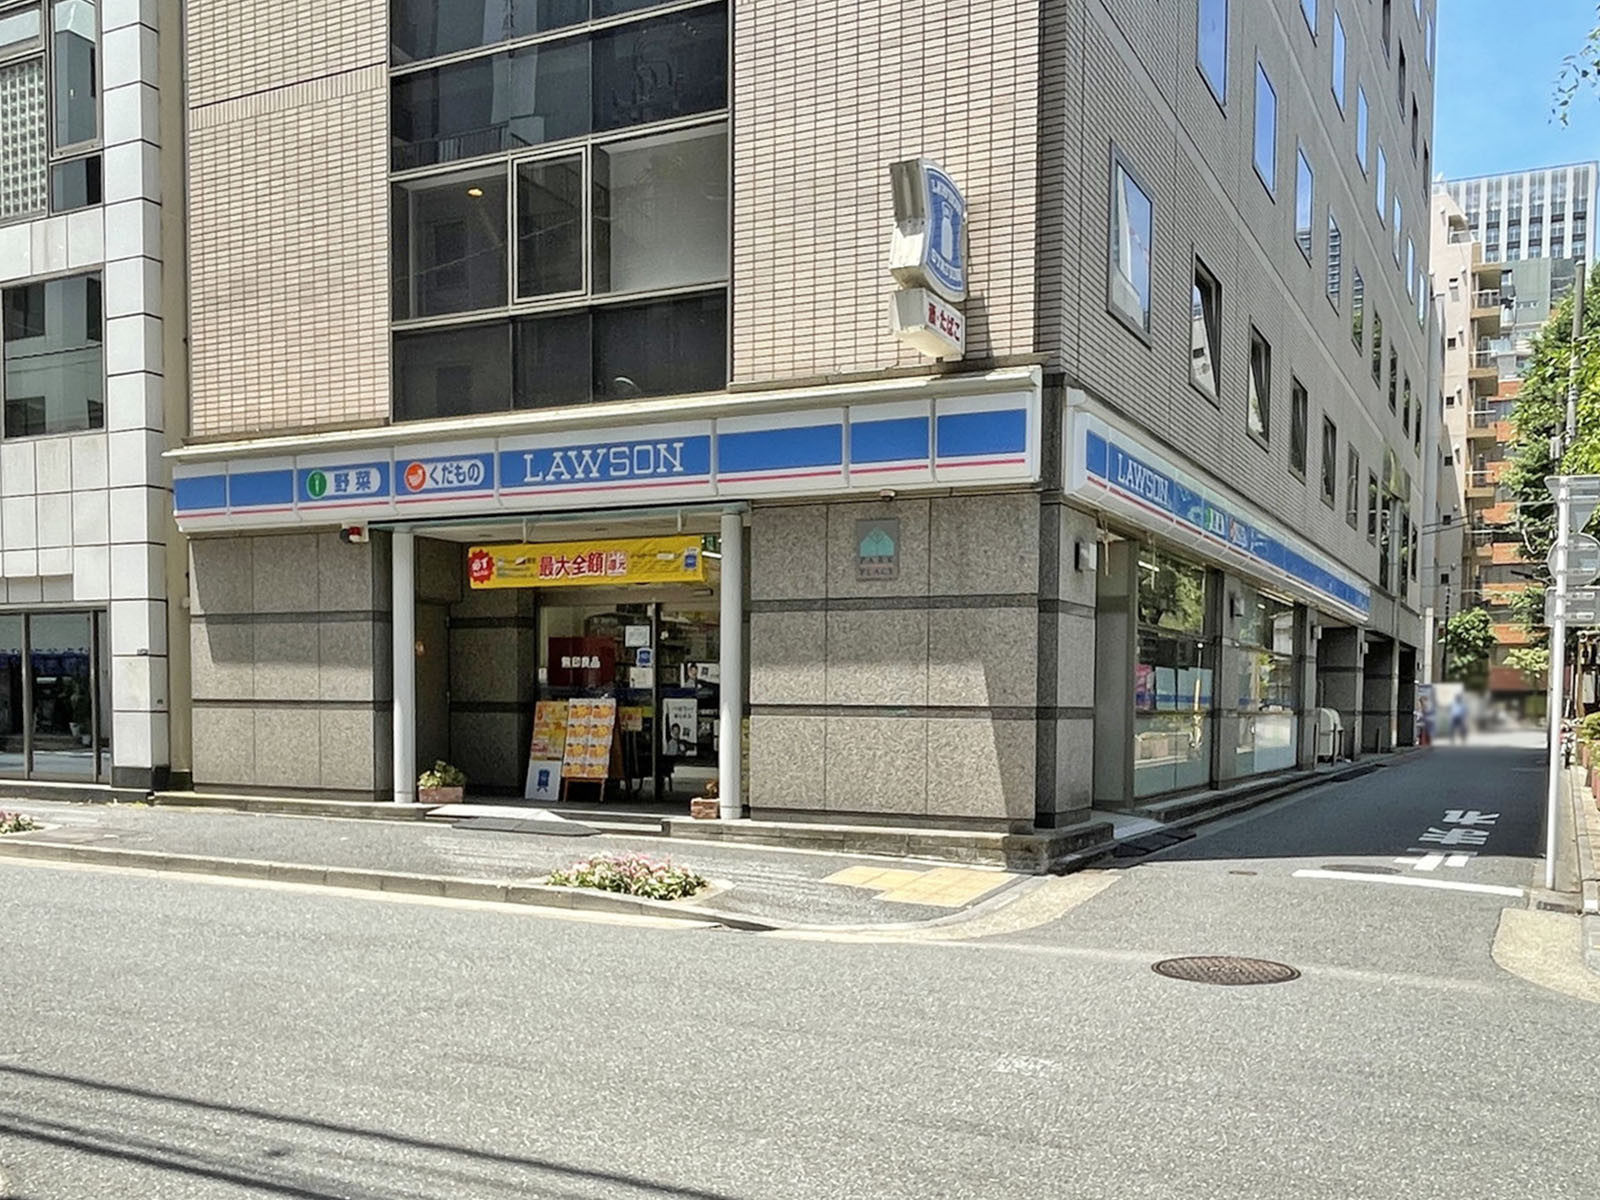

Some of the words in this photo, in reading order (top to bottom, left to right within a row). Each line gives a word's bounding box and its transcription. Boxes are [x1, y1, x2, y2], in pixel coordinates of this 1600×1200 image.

[429, 462, 481, 486] くだもの
[523, 442, 684, 483] LAWSON
[333, 470, 372, 493] 野菜
[1117, 453, 1169, 505] LAWSON
[560, 655, 601, 669] 無印良品
